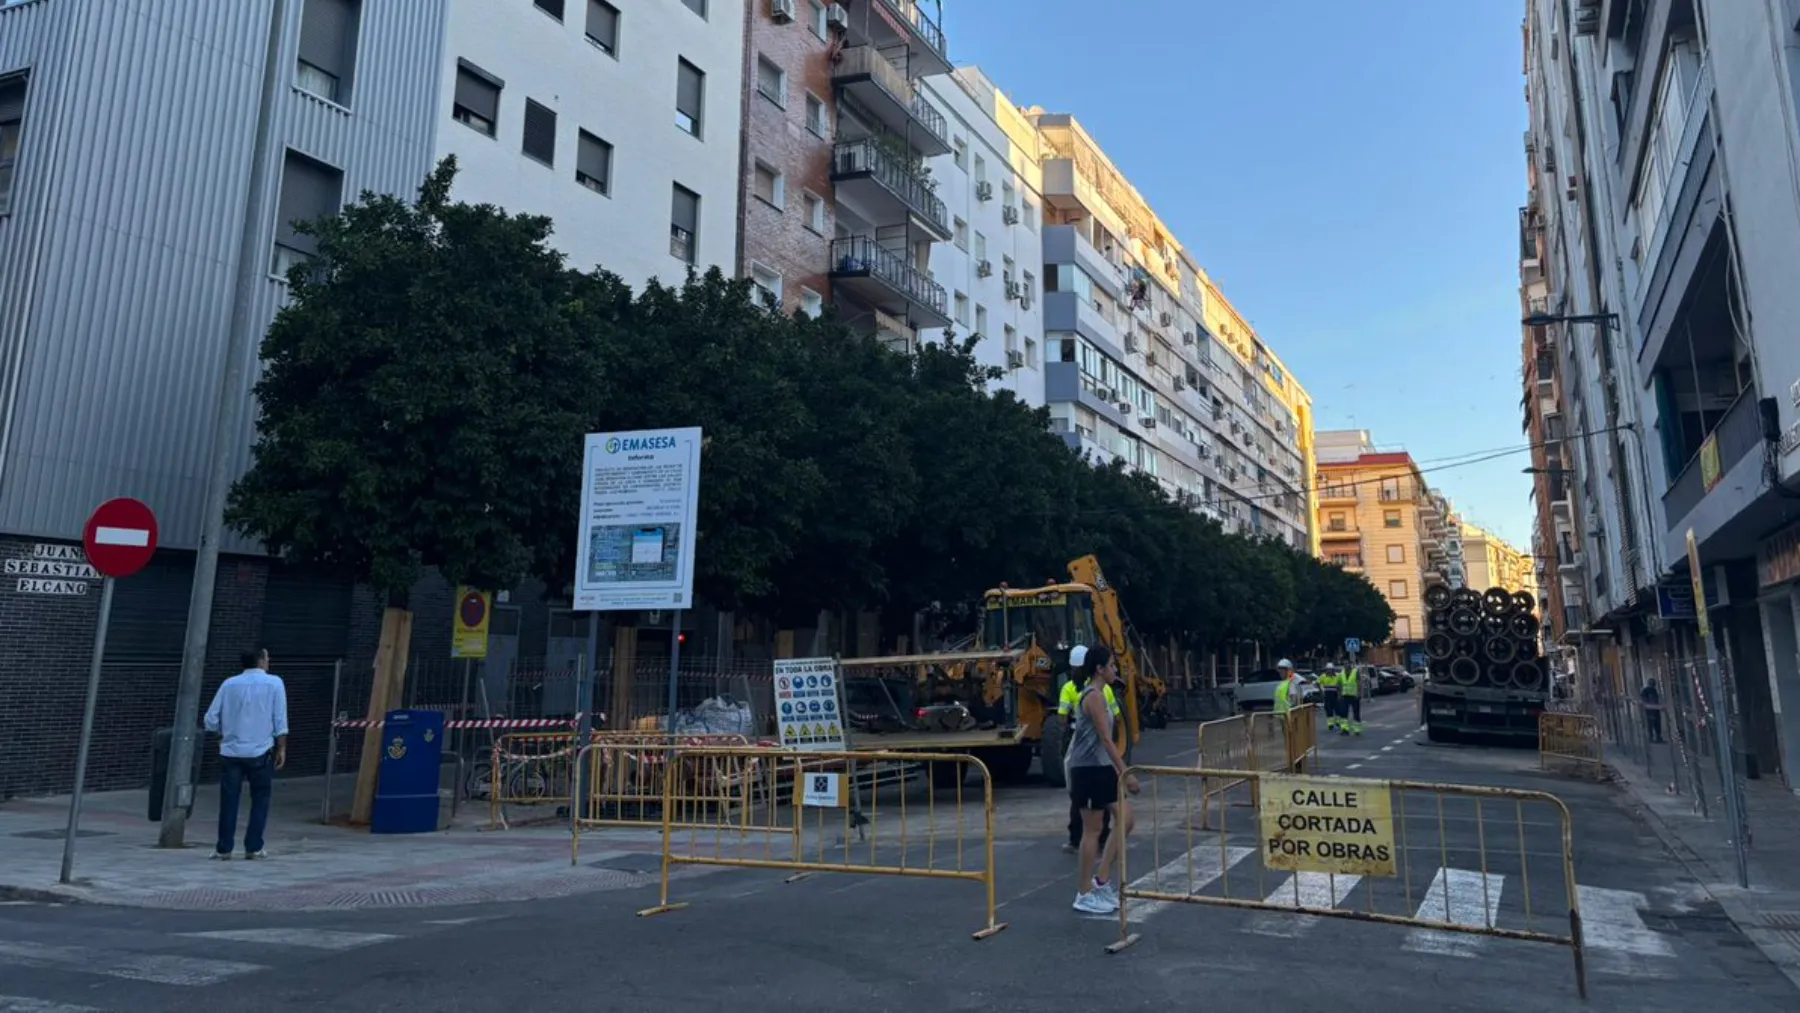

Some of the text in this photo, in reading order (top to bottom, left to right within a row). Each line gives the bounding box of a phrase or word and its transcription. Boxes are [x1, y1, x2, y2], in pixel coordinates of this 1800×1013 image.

[621, 436, 676, 451] EMASESA
[36, 544, 80, 558] JUAN
[19, 579, 86, 593] ELCANO
[1292, 789, 1357, 807] CALLE
[1278, 814, 1377, 834] CORTADA
[1269, 838, 1389, 861] POR OBRAS
